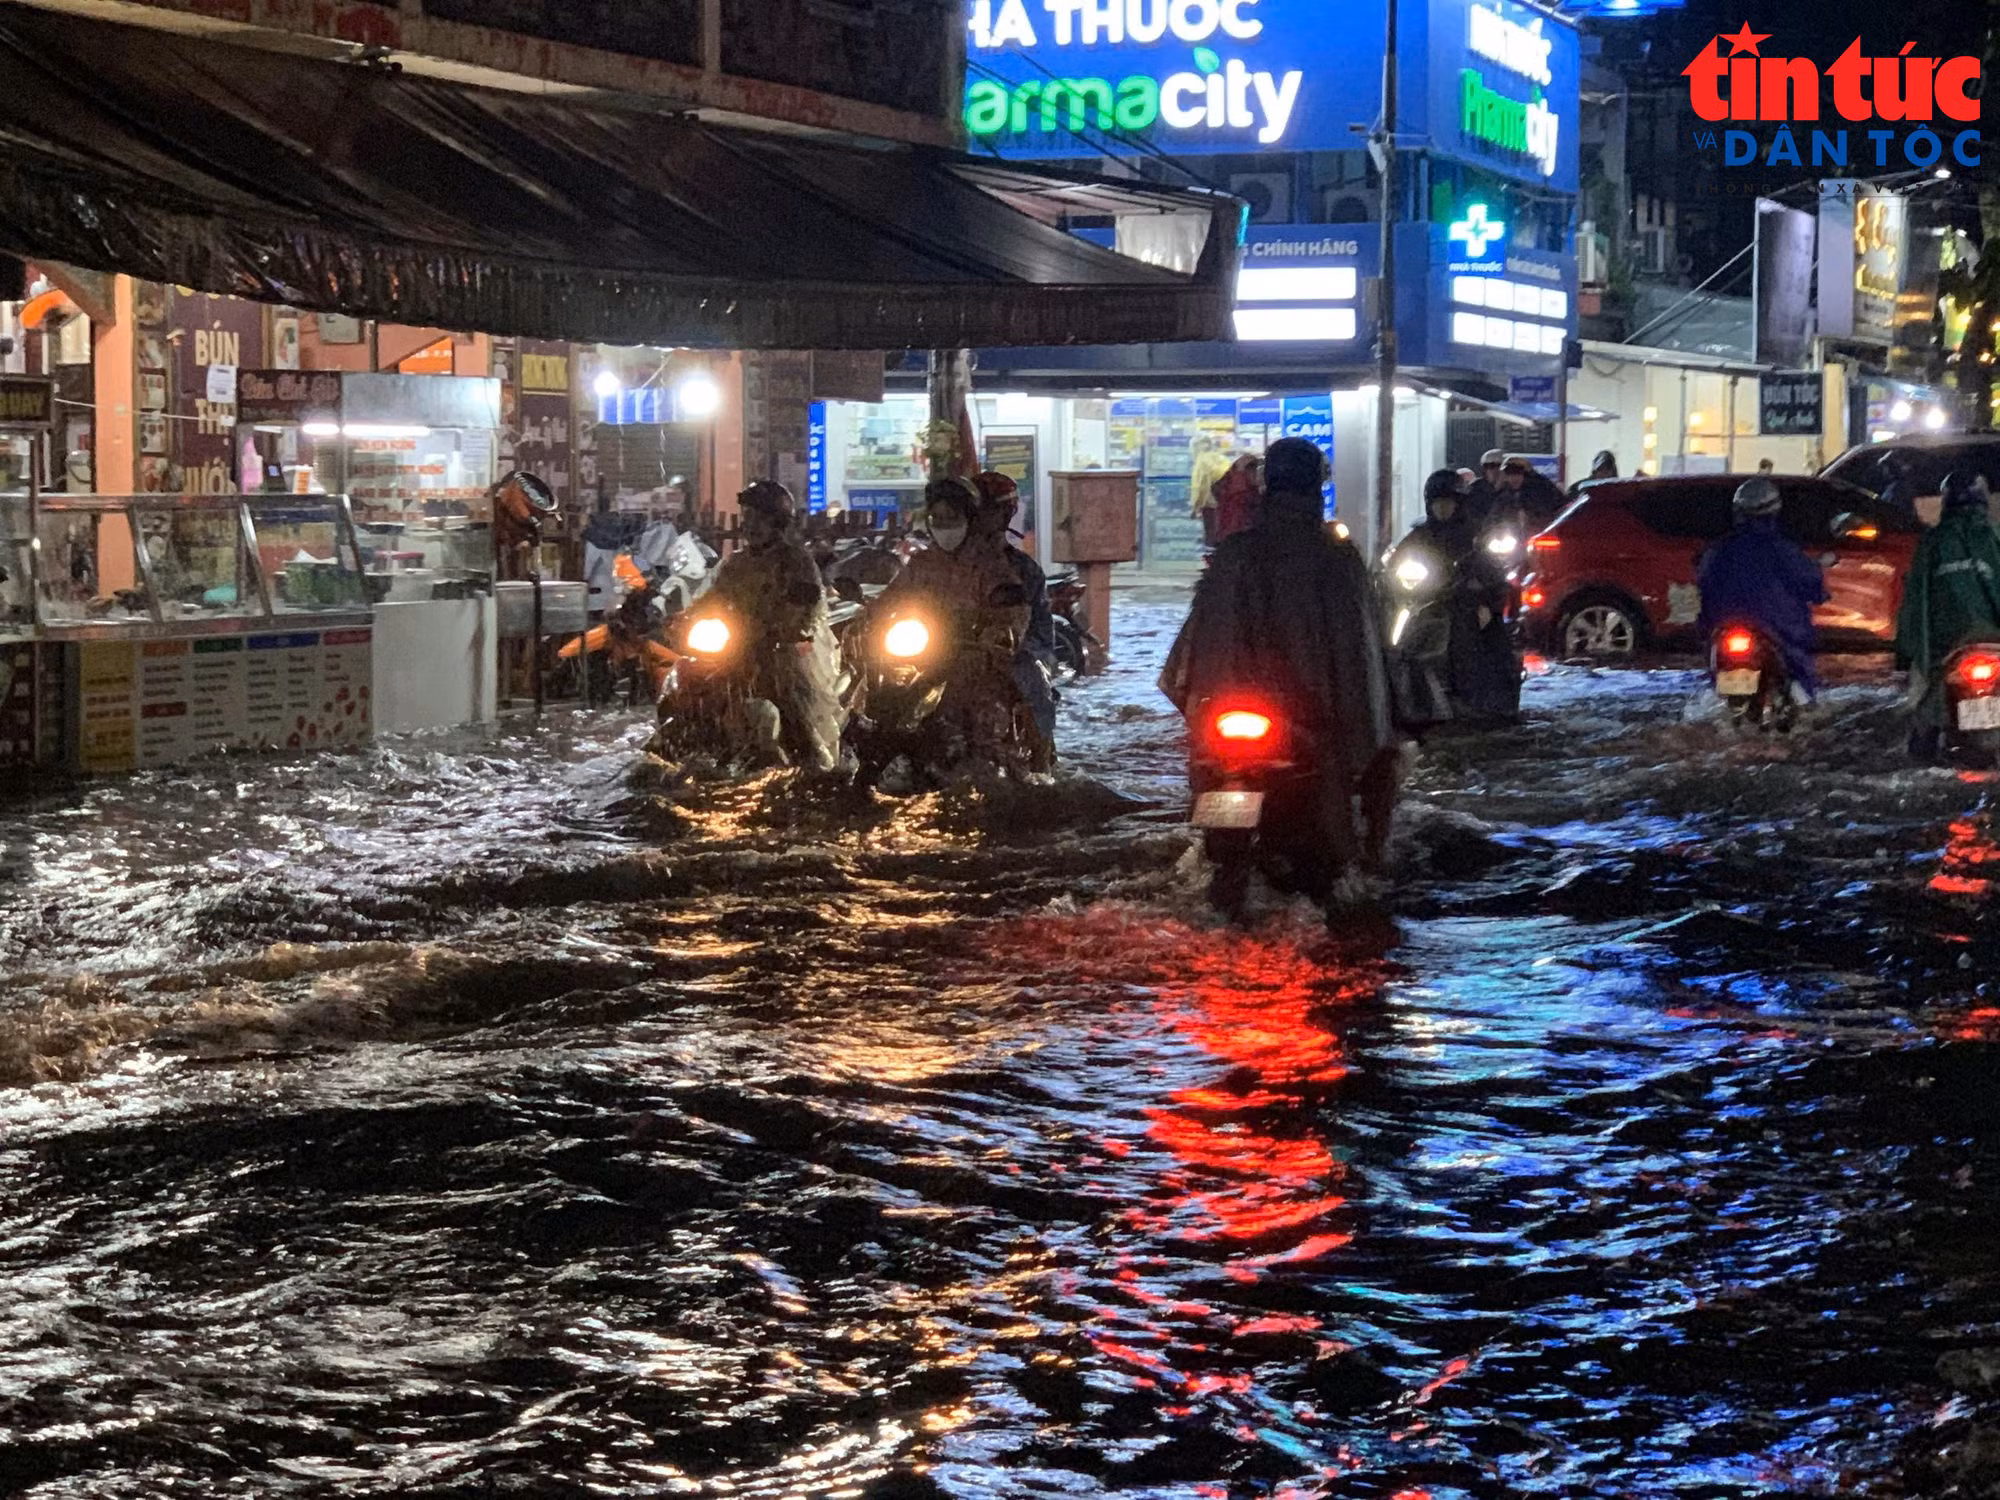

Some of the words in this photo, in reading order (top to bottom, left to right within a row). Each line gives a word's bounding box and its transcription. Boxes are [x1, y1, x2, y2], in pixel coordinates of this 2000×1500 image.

[1252, 239, 1306, 256] CHÍNH
[195, 319, 240, 367] BÚN
[1286, 423, 1331, 437] CAM
